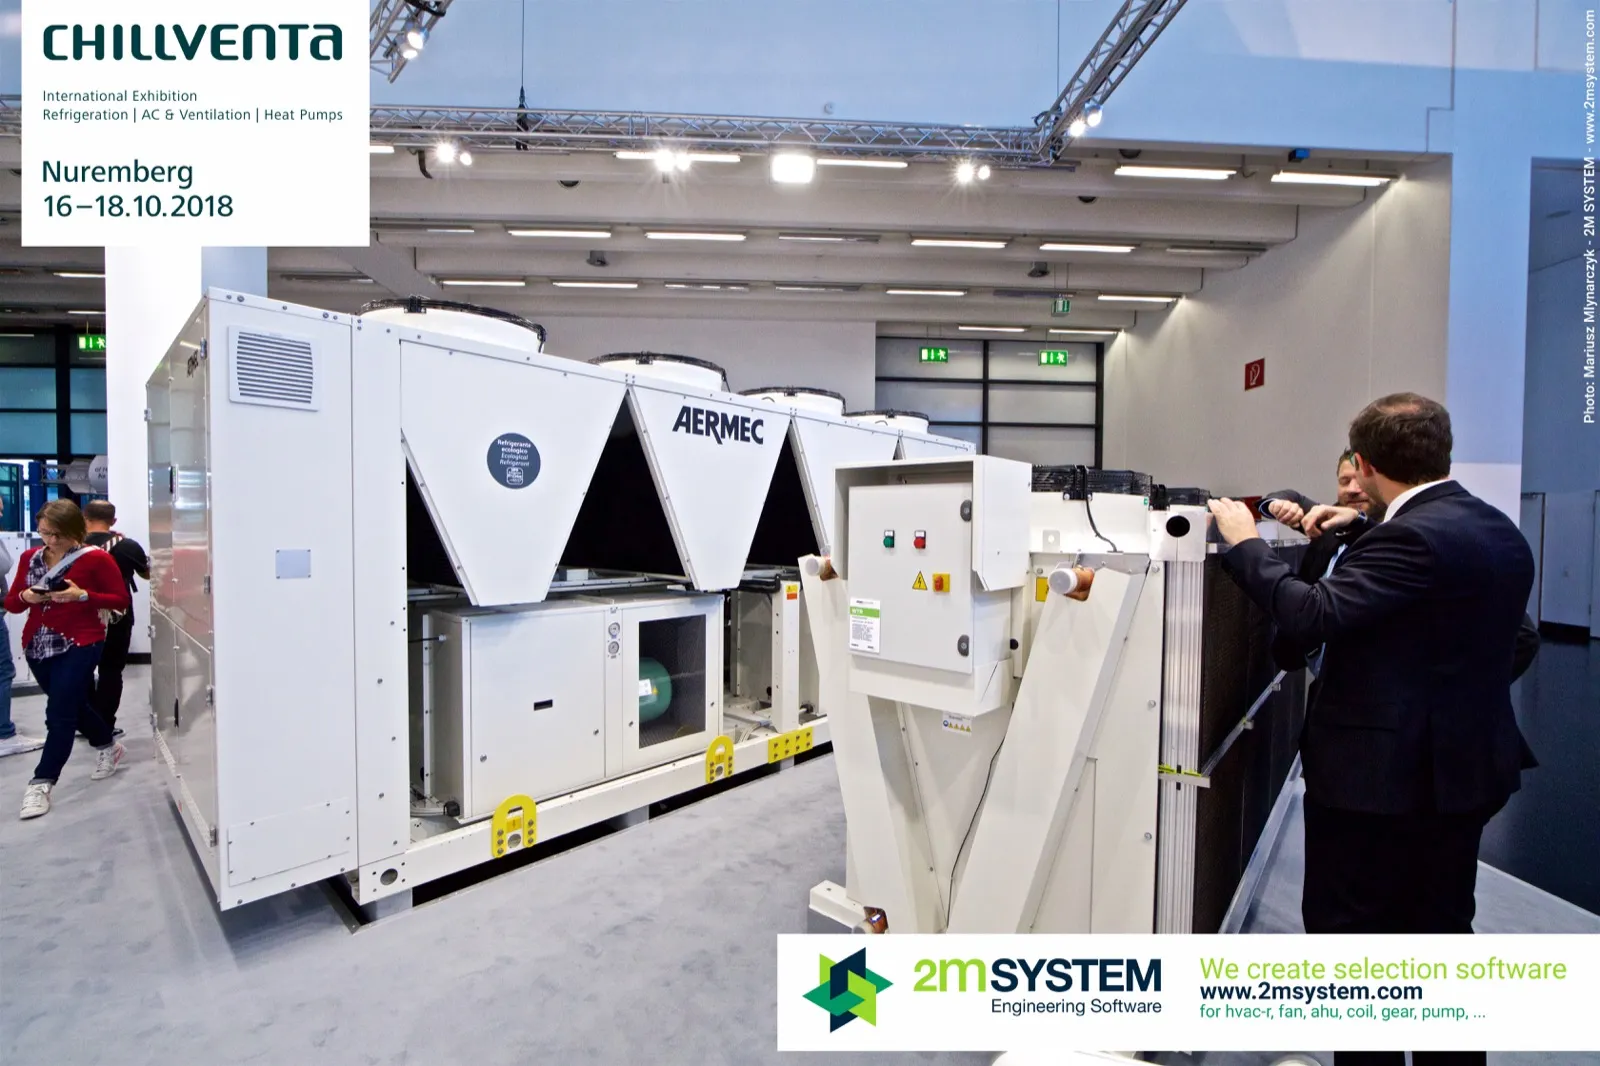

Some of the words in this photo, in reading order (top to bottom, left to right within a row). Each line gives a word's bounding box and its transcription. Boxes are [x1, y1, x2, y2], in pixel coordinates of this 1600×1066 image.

[672, 405, 764, 445] AERMEC
[497, 439, 532, 448] Refrigerante
[501, 447, 528, 455] ecologico
[501, 452, 529, 461] Ecological
[499, 459, 530, 467] Refrigerant
